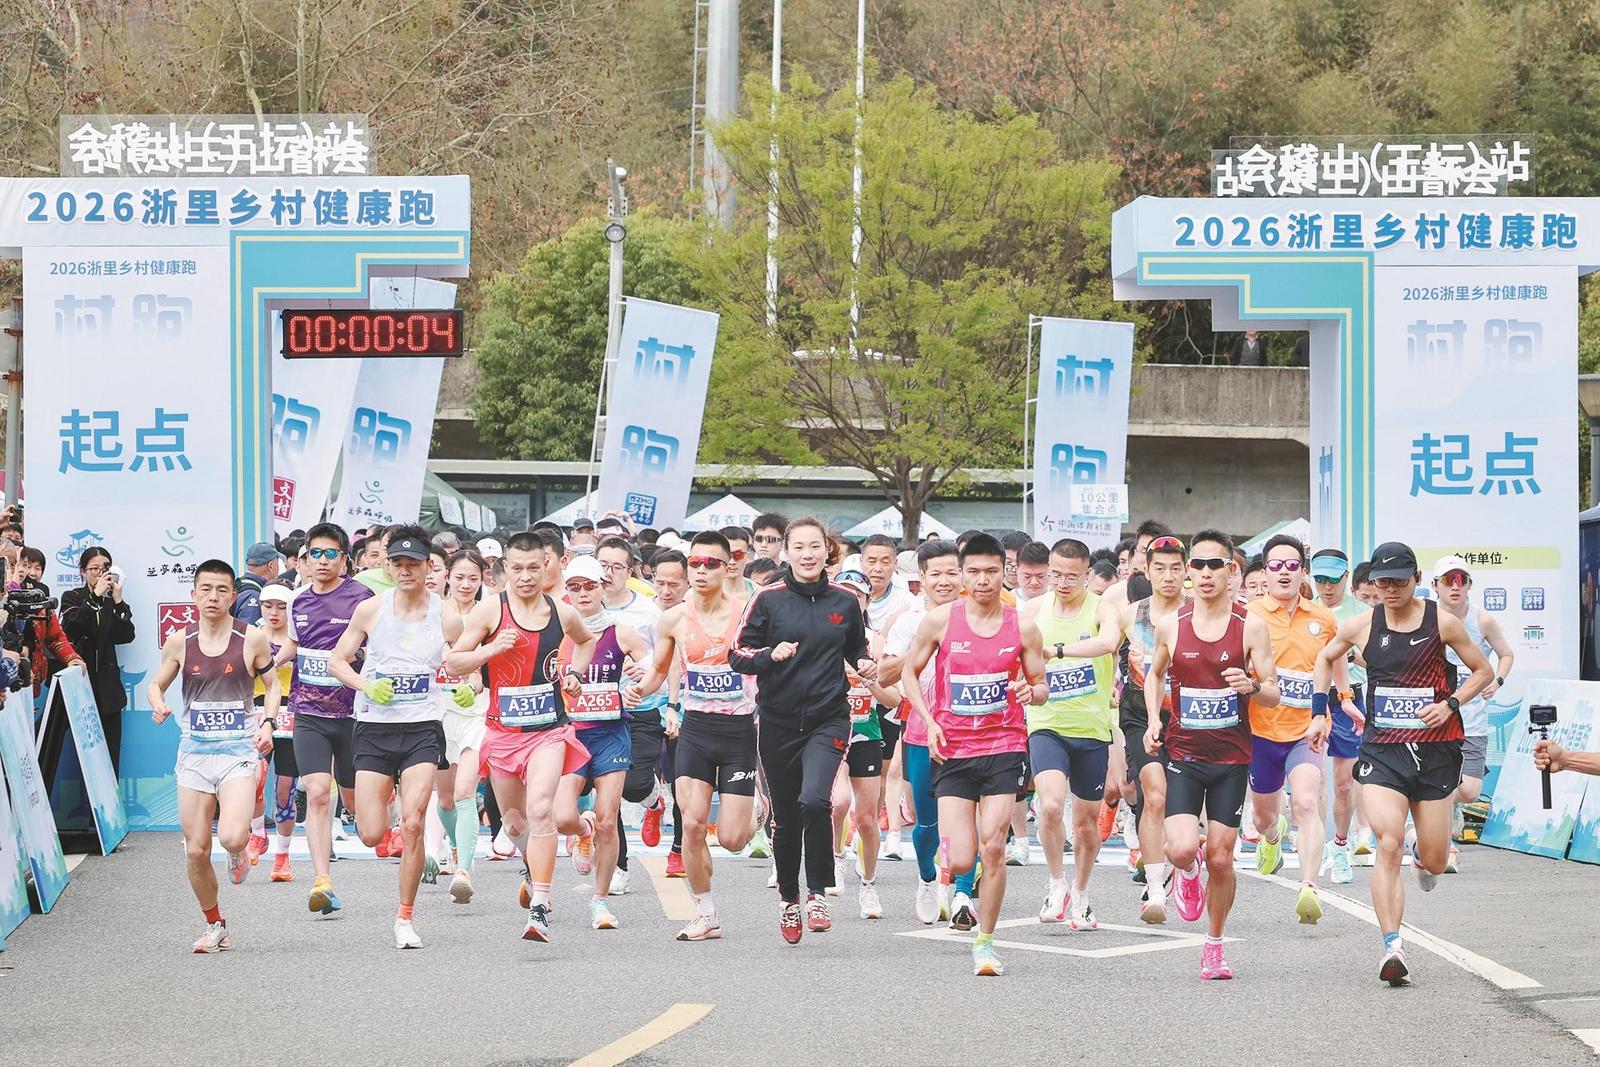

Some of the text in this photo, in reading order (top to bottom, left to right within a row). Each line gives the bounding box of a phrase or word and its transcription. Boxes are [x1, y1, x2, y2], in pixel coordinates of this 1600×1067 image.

[27, 189, 436, 226] 2026浙里乡村健康跑
[1175, 213, 1579, 250] 2026浙里乡村健康跑
[50, 260, 197, 276] 2026浙里乡村健康跑
[1403, 286, 1548, 301] 2026浙里乡村健康跑
[289, 315, 454, 352] 00:00:04
[59, 408, 192, 474] 起点
[1410, 432, 1541, 497] 起点
[1080, 492, 1119, 503] 10公里
[629, 503, 654, 518] 乡村
[708, 514, 752, 525] 存衣区
[147, 563, 197, 577] 兰亭森呼
[303, 659, 328, 672] A39
[392, 677, 421, 690] 357
[696, 675, 733, 688] A300
[1050, 671, 1086, 687] A362
[961, 685, 1000, 700] A120
[1278, 680, 1310, 694] A450
[509, 696, 546, 712] A317
[577, 695, 613, 707] A265
[1189, 700, 1230, 714] A373
[1383, 700, 1424, 713] A282
[196, 713, 235, 726] A330
